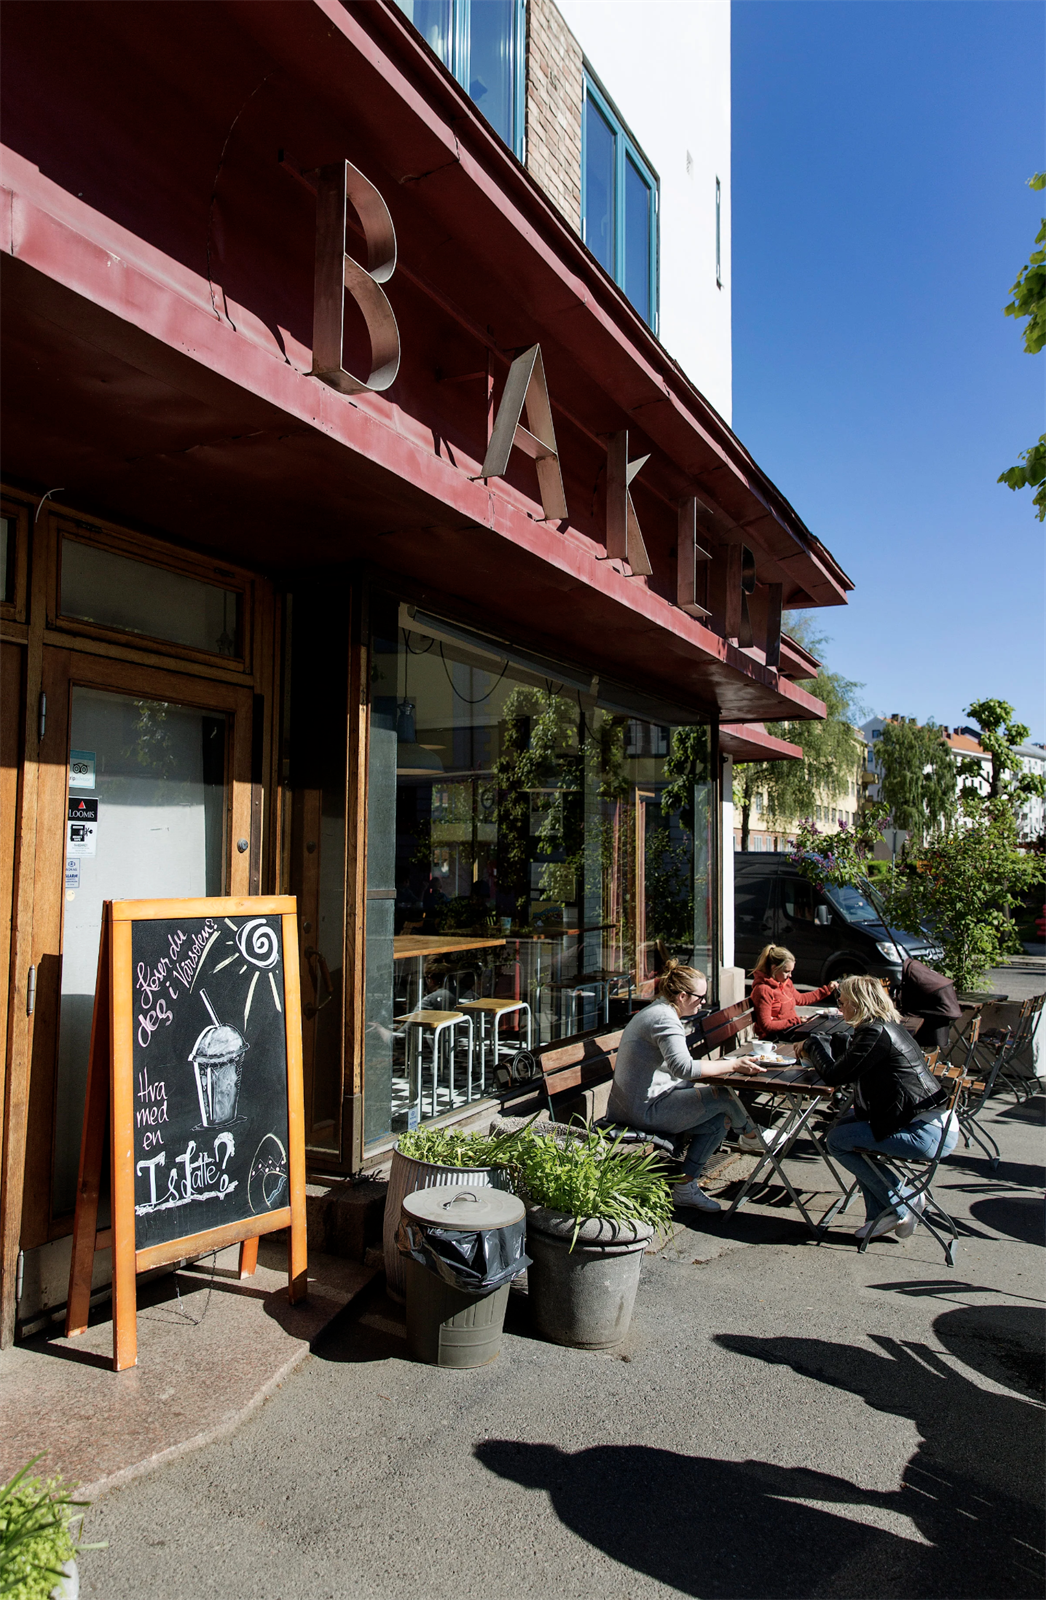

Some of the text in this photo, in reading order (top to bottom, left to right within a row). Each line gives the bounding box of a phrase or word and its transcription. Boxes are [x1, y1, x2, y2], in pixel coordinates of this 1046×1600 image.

[311, 159, 783, 667] BAKERI
[68, 809, 95, 819] LOOMIS
[168, 929, 187, 961] du
[137, 998, 174, 1047] deg
[165, 981, 179, 1000] i
[137, 1066, 168, 1103] Hva
[136, 1100, 170, 1128] med
[142, 1129, 165, 1150] en
